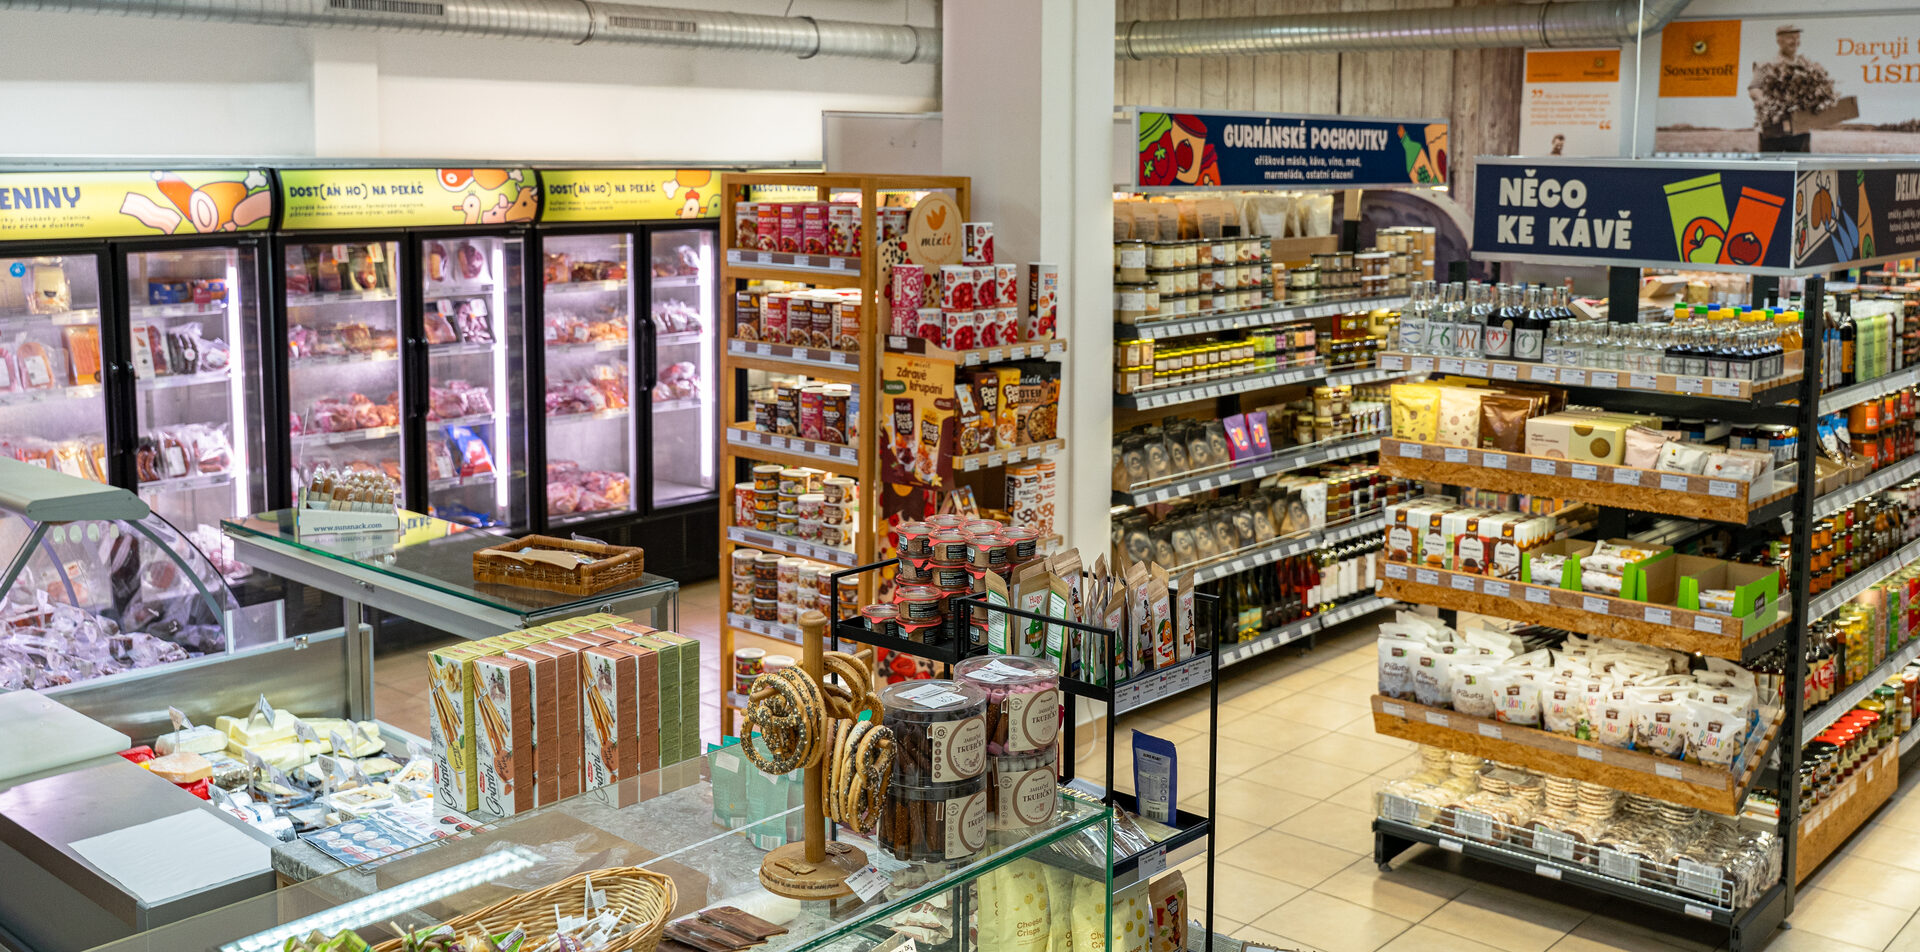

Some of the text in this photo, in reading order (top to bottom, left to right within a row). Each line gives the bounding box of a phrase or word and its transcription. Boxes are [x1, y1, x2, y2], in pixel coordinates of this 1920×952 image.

[1836, 37, 1909, 60] Daruji
[1223, 119, 1388, 151] GURMÁNSKÉ POCHOUTKY
[1254, 155, 1362, 168] oříšková másla, káva, víno, med,
[1264, 170, 1305, 180] marmeláda,
[1306, 169, 1330, 179] ostatní
[372, 185, 387, 196] NA
[391, 181, 424, 195] PEKÁČ
[615, 184, 626, 193] NA
[630, 181, 656, 193] PEKÁČ
[1499, 169, 1588, 208] NĚCO
[0, 187, 81, 210] ENINY
[1497, 209, 1633, 250] KE KÁVĚ
[921, 233, 952, 248] mixit
[896, 367, 927, 381] Zdravé
[909, 380, 943, 397] křupání
[313, 522, 382, 533] www.sunsnack.com
[1029, 594, 1043, 605] Hugo
[1158, 603, 1168, 614] Hugo
[1456, 689, 1484, 701] Piškoty
[438, 754, 458, 809] Grissini
[483, 763, 505, 818] Grissini
[1017, 917, 1043, 930] Cheese
[1017, 927, 1041, 938] Crisps
